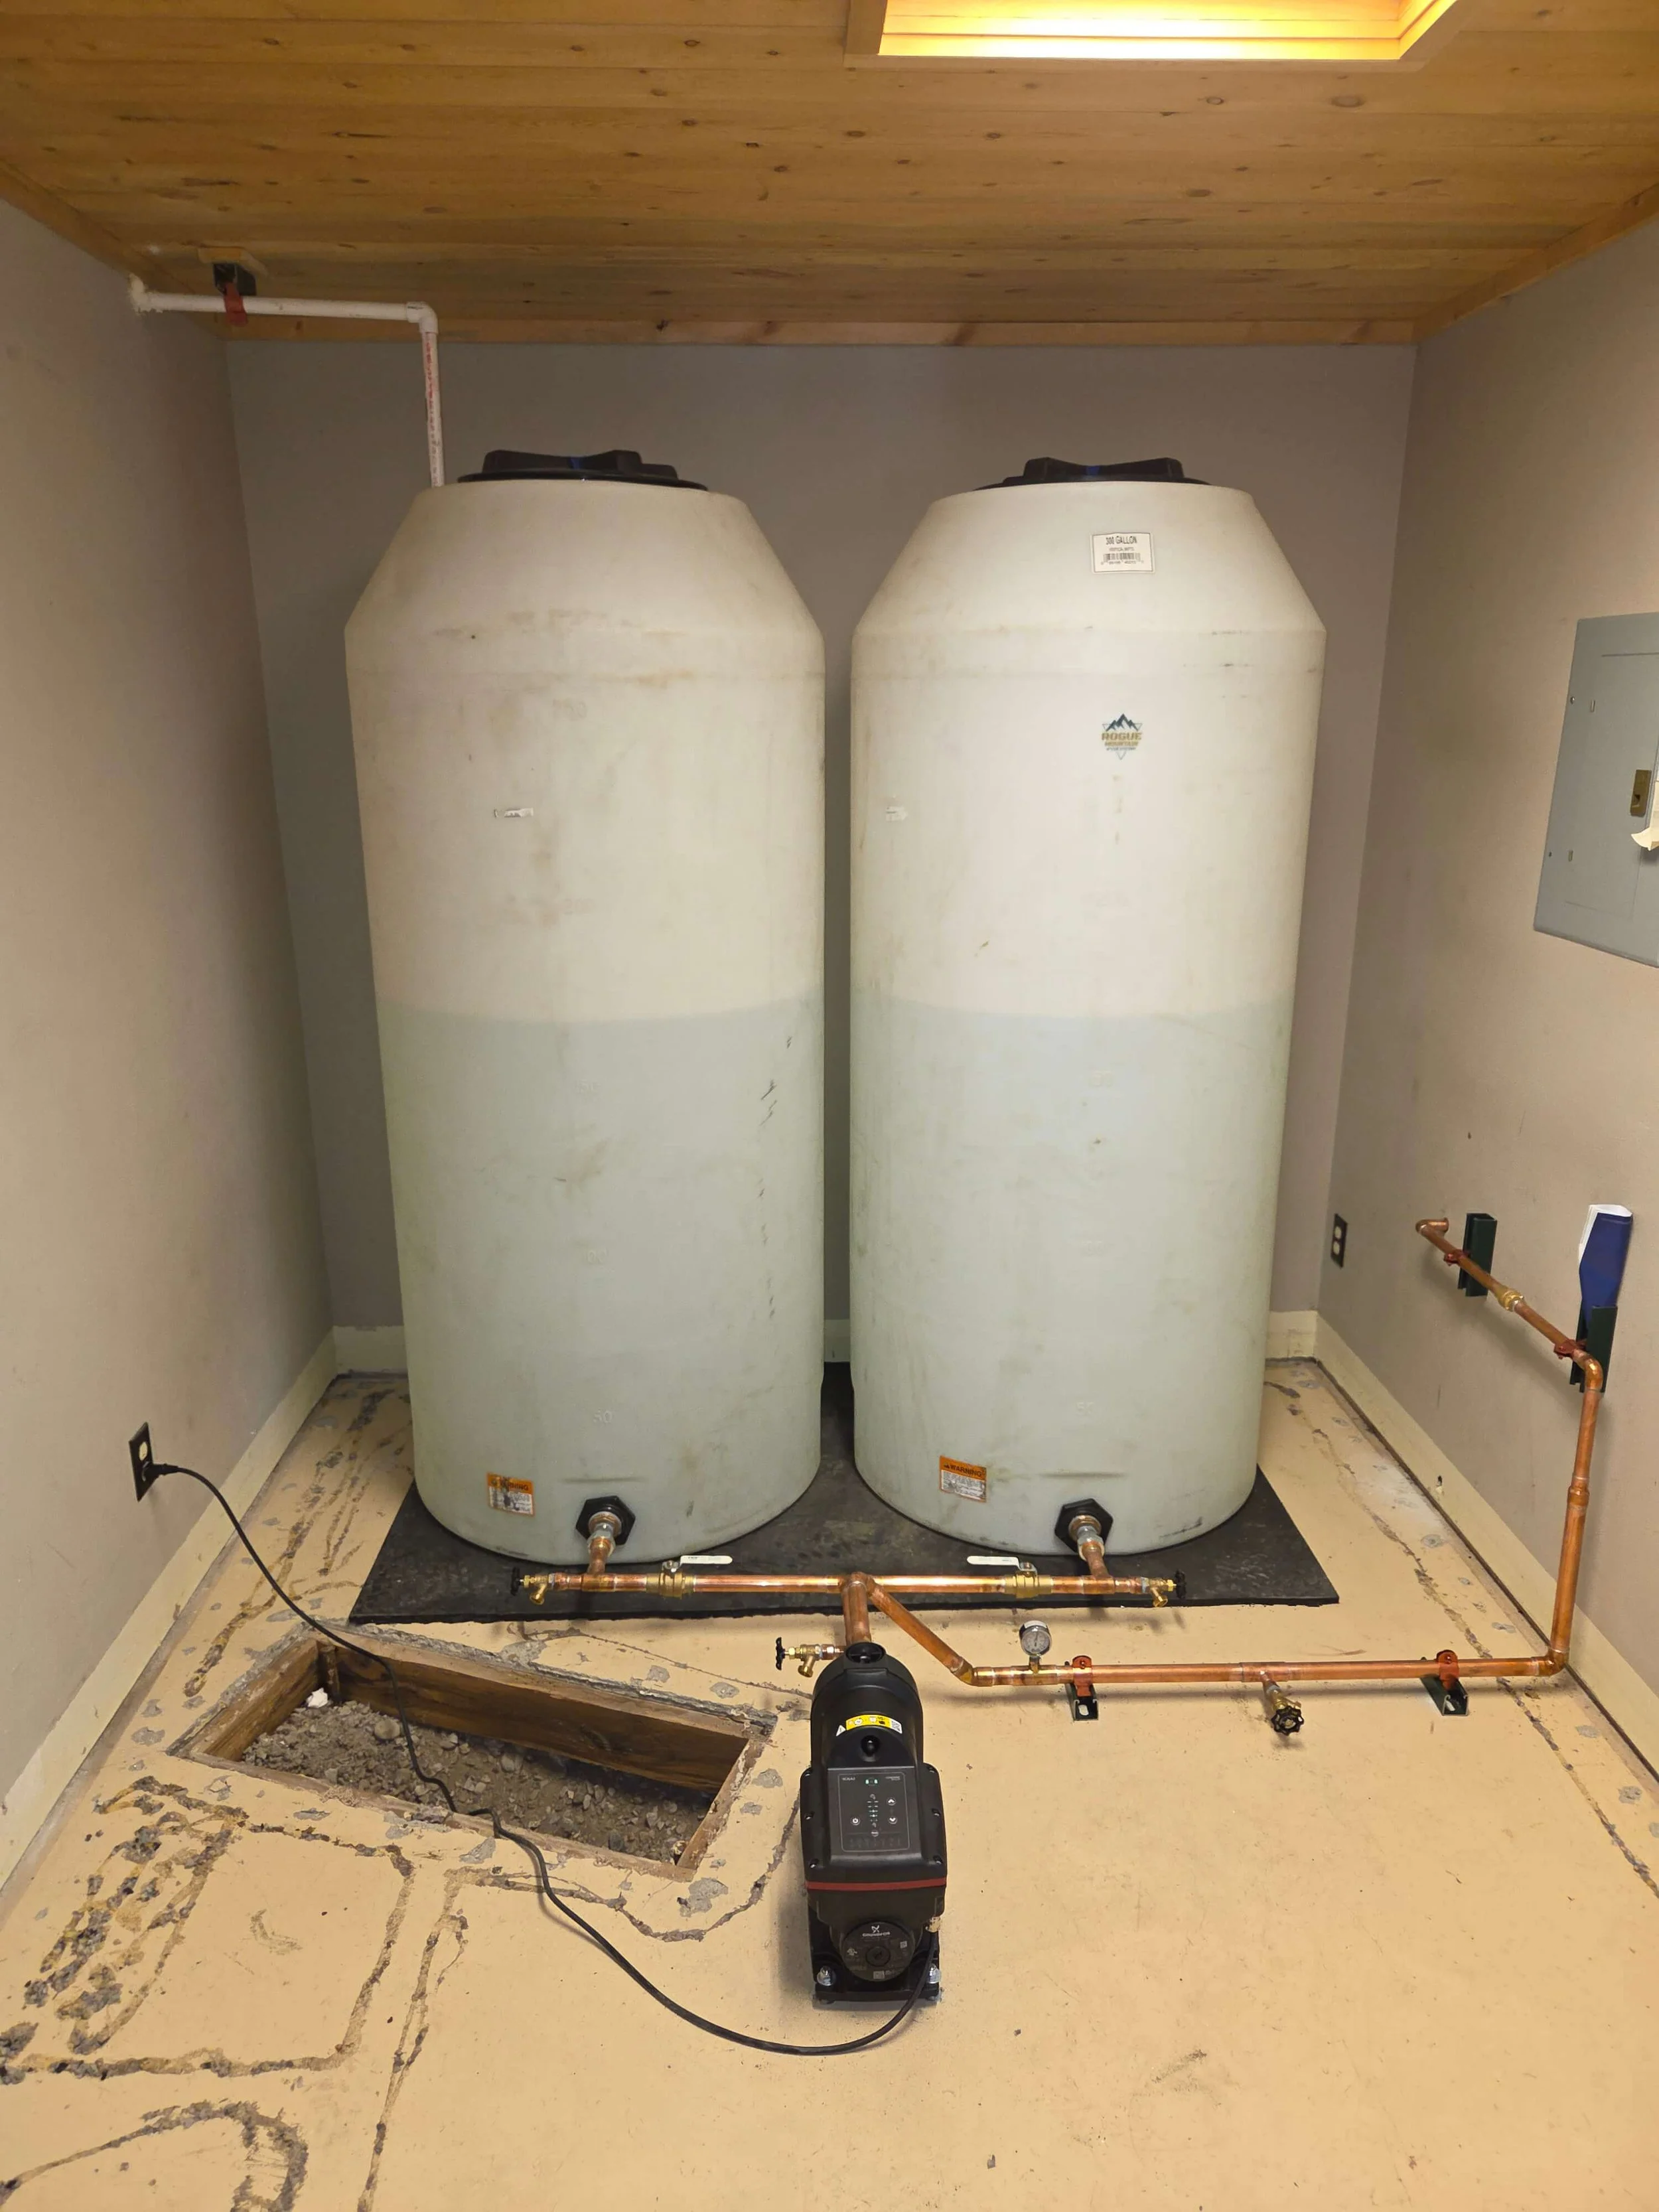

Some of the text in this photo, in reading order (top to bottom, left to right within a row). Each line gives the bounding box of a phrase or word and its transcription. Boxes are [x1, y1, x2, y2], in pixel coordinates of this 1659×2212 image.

[1116, 536, 1137, 544] GALLON
[1102, 732, 1142, 741] ROGUE
[950, 1463, 983, 1477] WARNING
